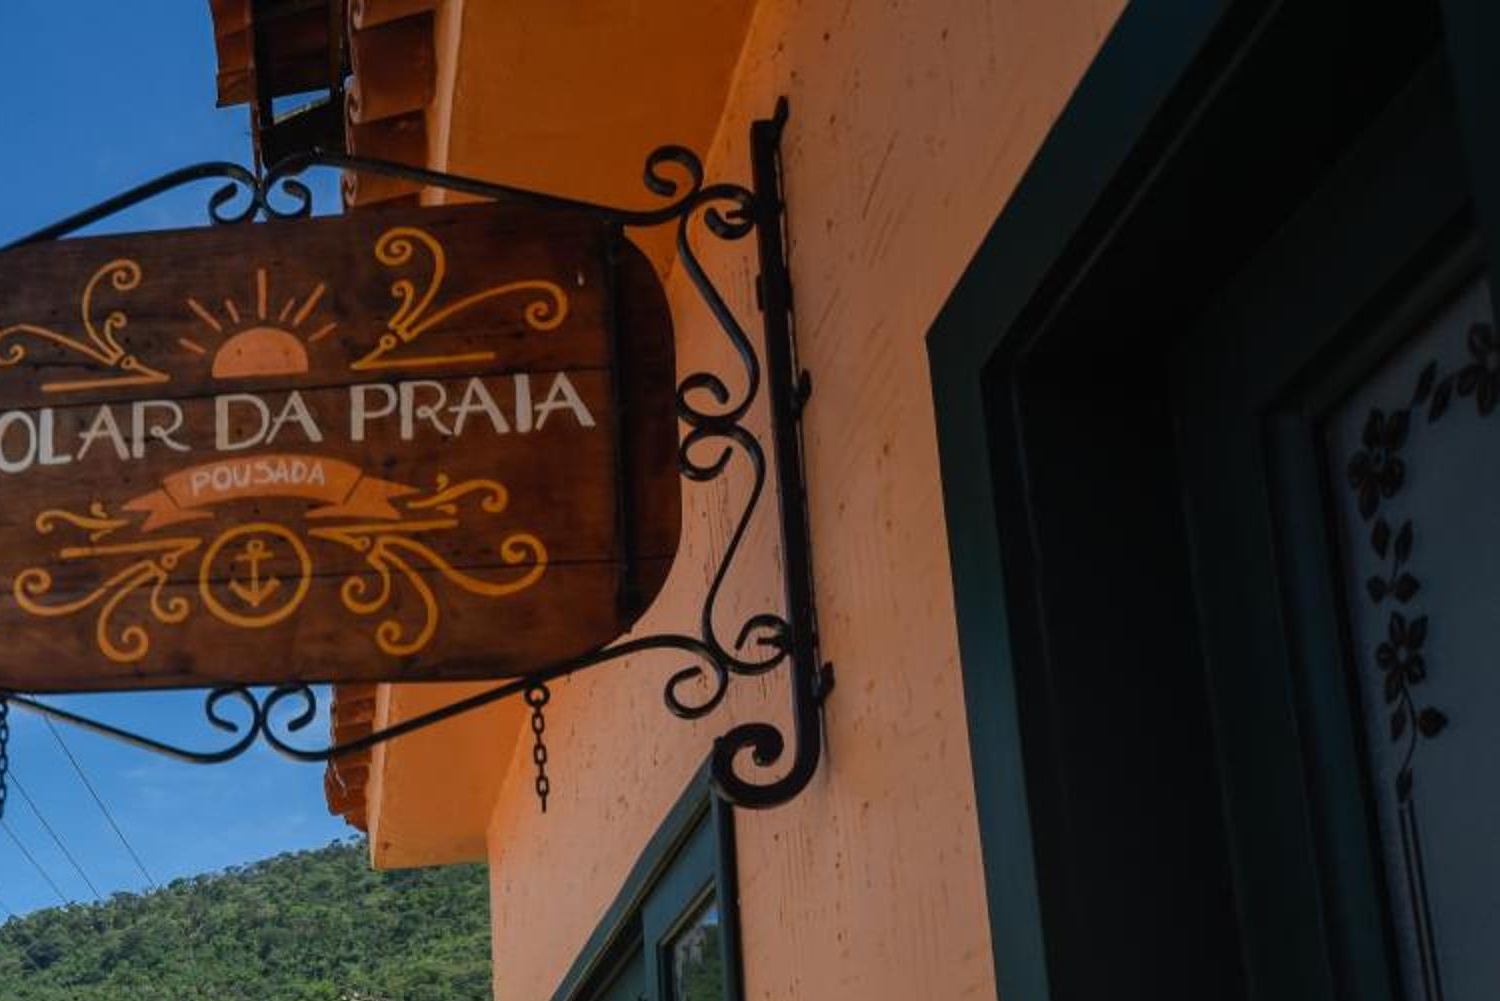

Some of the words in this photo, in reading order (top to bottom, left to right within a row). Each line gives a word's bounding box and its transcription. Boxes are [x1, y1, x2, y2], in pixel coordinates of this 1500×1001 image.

[214, 390, 324, 451] DA
[350, 371, 597, 442] PRAIA
[189, 460, 325, 496] POUSADA
